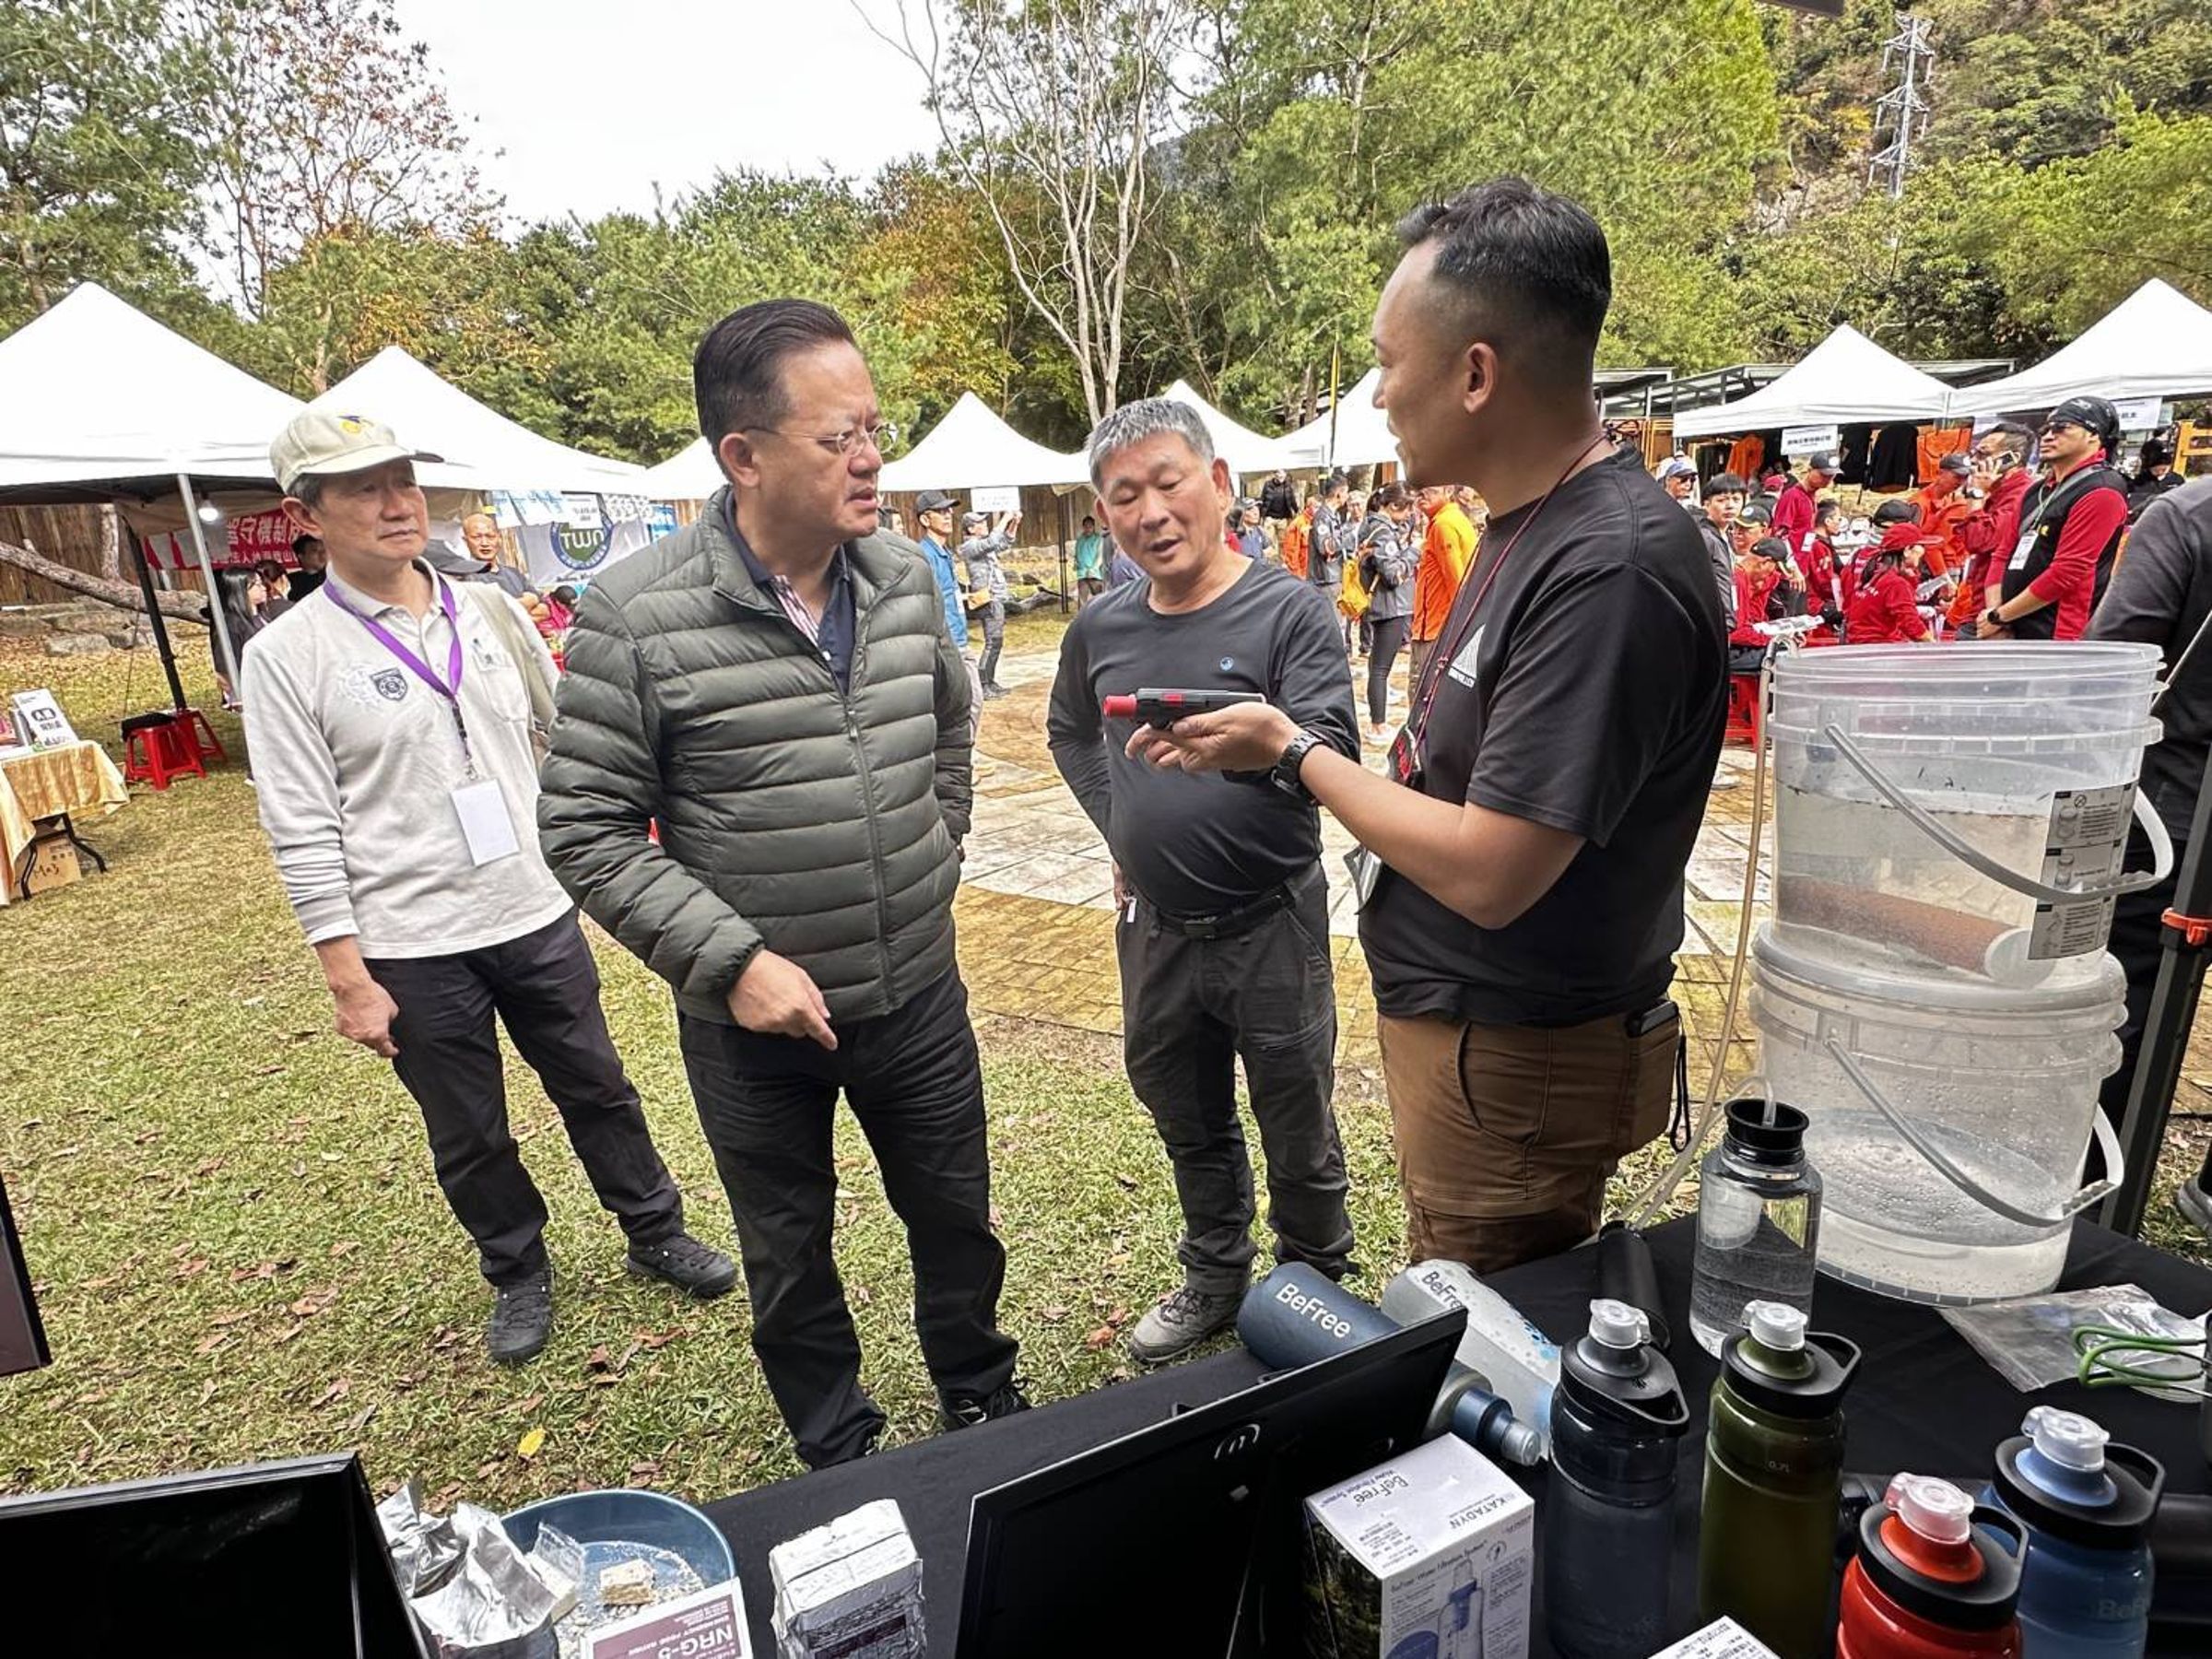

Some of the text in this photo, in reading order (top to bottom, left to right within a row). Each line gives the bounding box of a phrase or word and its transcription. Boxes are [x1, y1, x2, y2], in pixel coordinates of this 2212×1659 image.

[1422, 1271, 1463, 1308] BeFre
[1276, 1283, 1351, 1338] BeFree
[1354, 1475, 1408, 1505] BeFree
[1450, 1496, 1507, 1529] KATADYN
[658, 1624, 733, 1659] NRG-5
